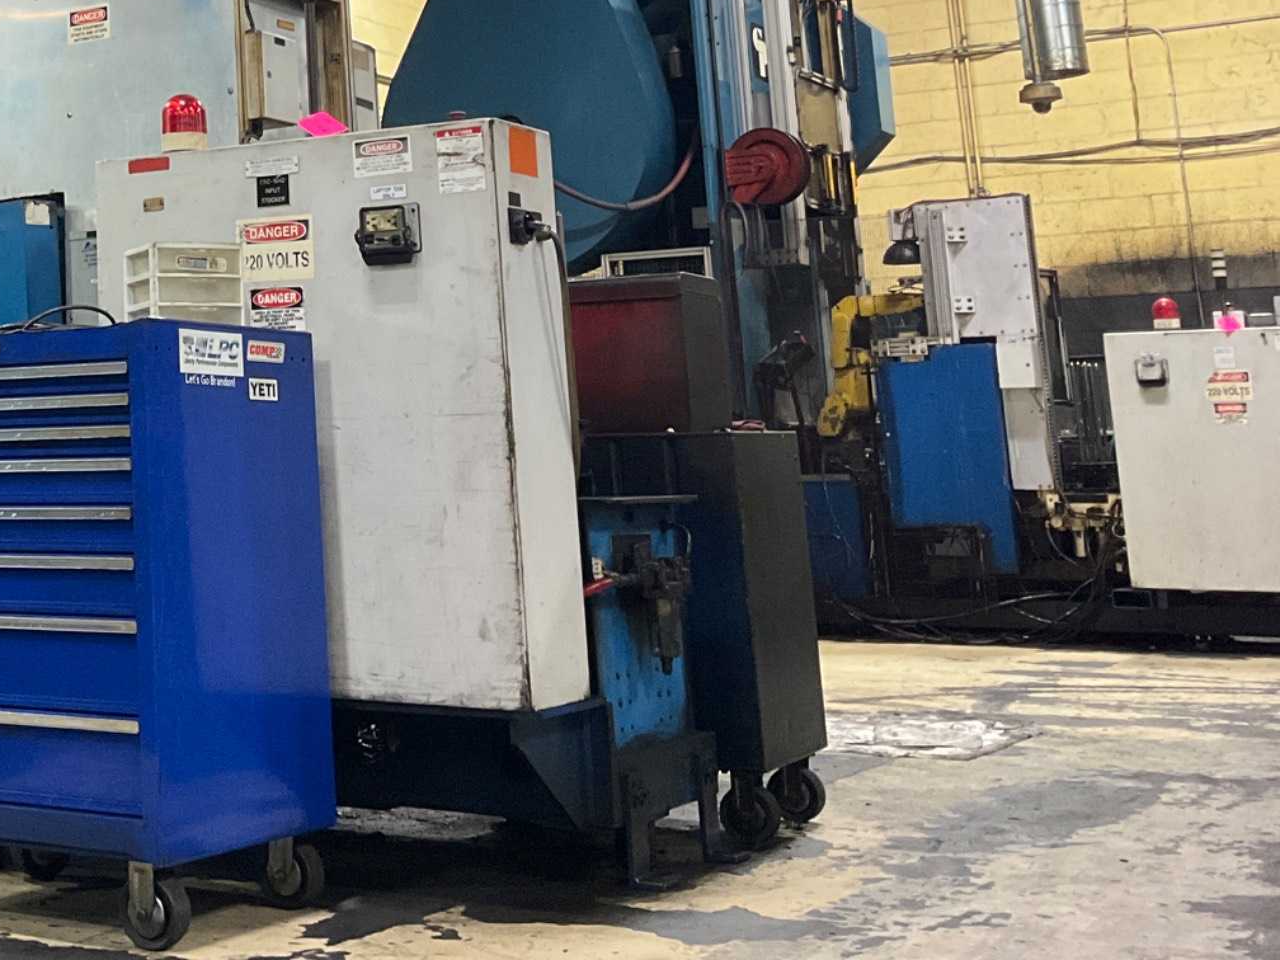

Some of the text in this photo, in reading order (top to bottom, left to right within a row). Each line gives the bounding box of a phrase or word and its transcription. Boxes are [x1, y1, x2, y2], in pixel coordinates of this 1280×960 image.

[366, 141, 398, 152] DANGER
[249, 225, 298, 240] DANGER
[267, 250, 310, 268] VOLTS
[257, 293, 297, 304] DANGER
[185, 374, 200, 385] Let's
[201, 375, 210, 386] Go
[250, 382, 276, 398] YETI
[1223, 385, 1250, 396] VOLTS
